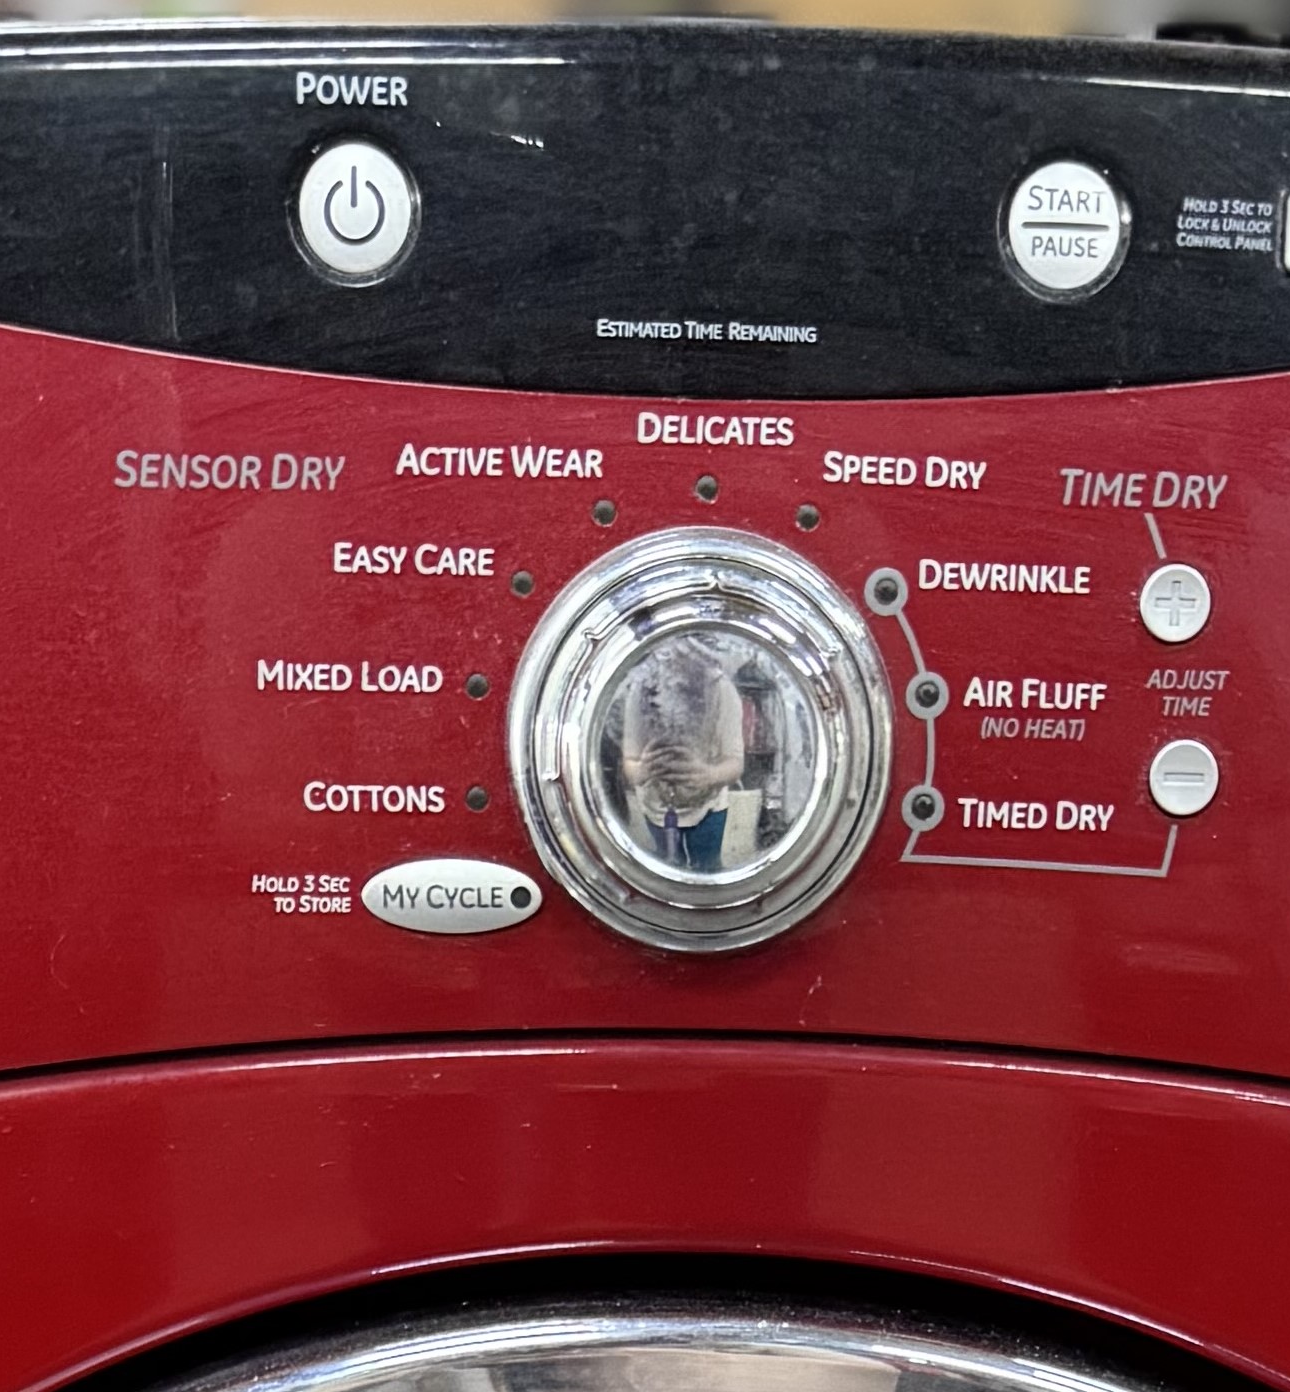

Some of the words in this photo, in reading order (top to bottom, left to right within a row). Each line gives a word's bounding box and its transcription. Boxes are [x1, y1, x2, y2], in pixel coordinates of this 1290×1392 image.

[296, 72, 407, 105] POWER
[1028, 185, 1107, 213] START
[1183, 196, 1218, 213] HOLD
[1220, 199, 1230, 214] 3
[1231, 200, 1255, 216] SEC
[1257, 202, 1272, 217] TO
[1177, 214, 1210, 230] LOCK
[1223, 218, 1273, 233] UNLOCK
[1032, 235, 1098, 258] PAUSE
[1176, 232, 1232, 250] CONTROL
[1235, 235, 1273, 252] PANEL
[596, 318, 682, 339] ESTIMATED
[684, 320, 723, 340] TIME
[728, 322, 818, 343] REMAINING
[637, 411, 794, 446] DELICATES
[114, 451, 261, 489] SENSOR
[270, 455, 346, 491] DRY
[396, 443, 502, 478] ACTIVE
[511, 446, 603, 479] WEAR
[823, 452, 917, 486] SPEED
[926, 455, 986, 490] DRY
[1059, 468, 1146, 508] TIME
[1153, 472, 1227, 510] DRY
[333, 542, 407, 574] EASY
[415, 543, 495, 577] CARE
[918, 558, 1091, 594] DEWRINKLE
[257, 660, 353, 693] MIXED
[361, 662, 443, 694] LOAD
[1147, 668, 1230, 692] ADJUST
[963, 678, 1012, 708] AIR
[1021, 681, 1108, 712] FLUFF
[1161, 695, 1211, 717] TIME
[980, 717, 1018, 739] (NO
[1023, 717, 1085, 742] HEAT)
[303, 781, 445, 814] COTTONS
[958, 797, 1048, 829] TIMED
[1056, 801, 1114, 832] DRY
[251, 874, 299, 894] HOLD
[303, 875, 315, 893] 3
[318, 875, 350, 893] SEC
[381, 884, 420, 910] MY
[425, 885, 504, 910] CYCLE
[274, 897, 295, 914] TO
[299, 895, 351, 914] STORE
